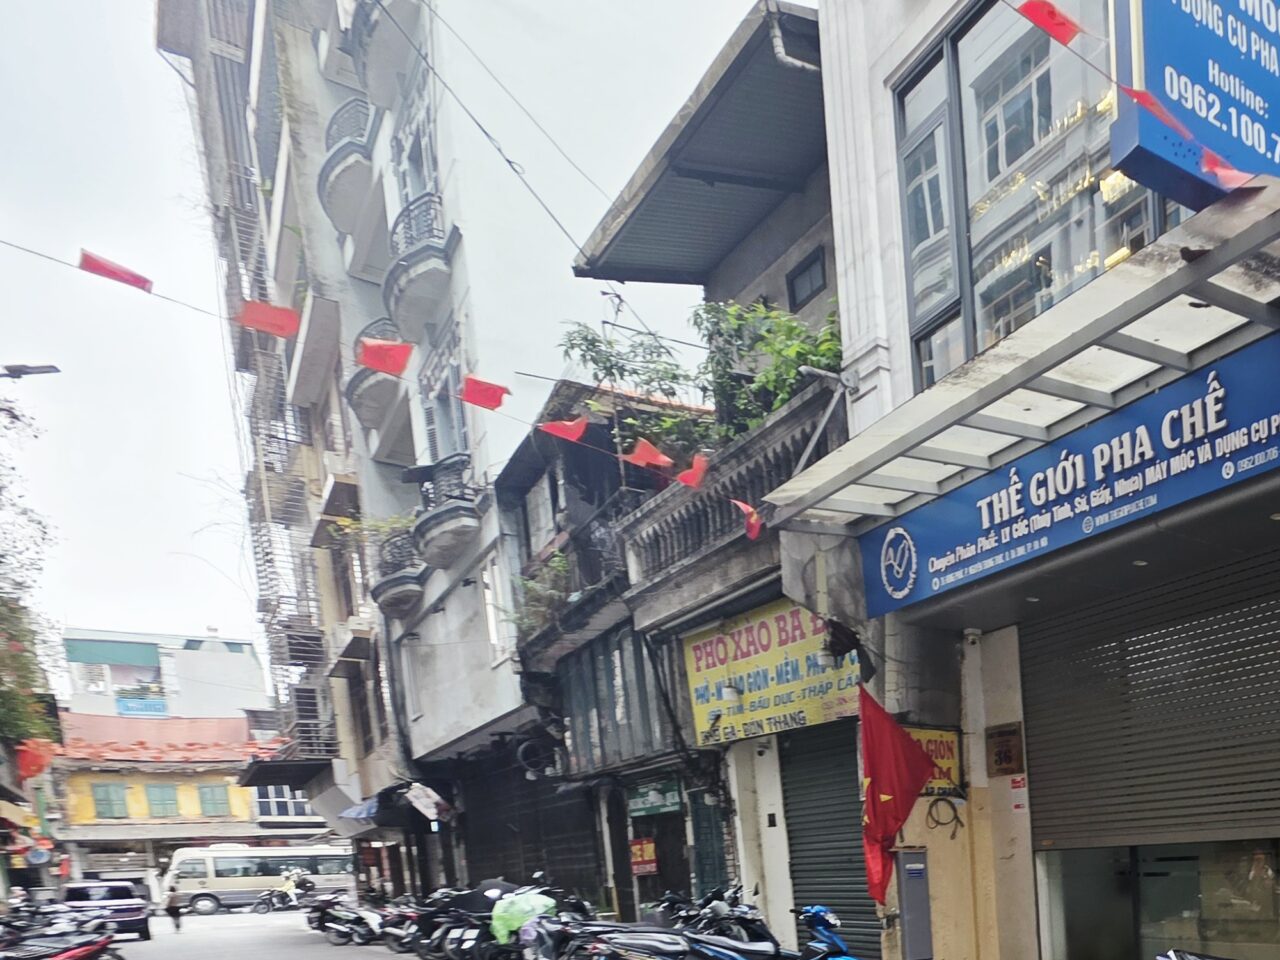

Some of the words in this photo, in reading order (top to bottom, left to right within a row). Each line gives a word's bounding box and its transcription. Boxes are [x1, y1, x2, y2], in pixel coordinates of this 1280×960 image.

[1227, 14, 1247, 60] CỤ
[1251, 33, 1279, 77] PHA
[1208, 59, 1269, 119] Hotline:
[976, 469, 1025, 530] THẾ
[1029, 448, 1087, 506] GIỚI
[1092, 424, 1153, 481] PHA
[1161, 370, 1228, 450] CHẾ
[1001, 526, 1011, 544] LY
[1012, 516, 1029, 538] CỐC
[1145, 459, 1167, 486] MÁY
[1170, 447, 1194, 476] MÓC
[1197, 438, 1213, 465] VÀ
[1215, 428, 1249, 459] DỤNG
[1251, 418, 1268, 444] CỤ
[730, 617, 772, 661] XÀO
